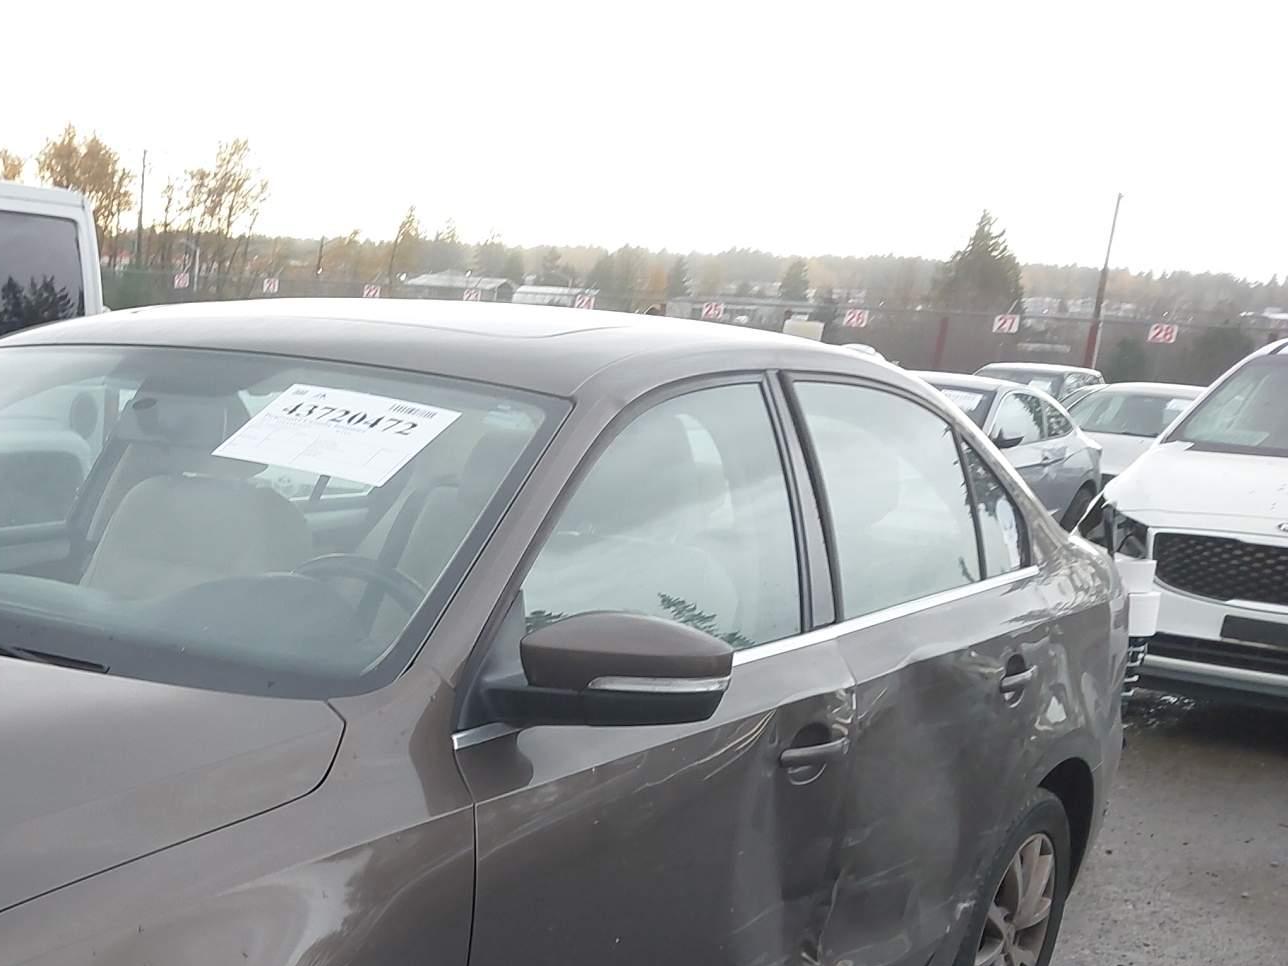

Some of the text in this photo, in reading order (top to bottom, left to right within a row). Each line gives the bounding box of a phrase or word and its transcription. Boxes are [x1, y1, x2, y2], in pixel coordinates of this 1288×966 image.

[703, 303, 722, 319] 25
[845, 310, 864, 327] 26
[996, 315, 1016, 332] 27
[1150, 325, 1174, 343] 28
[282, 402, 418, 436] 43720472
